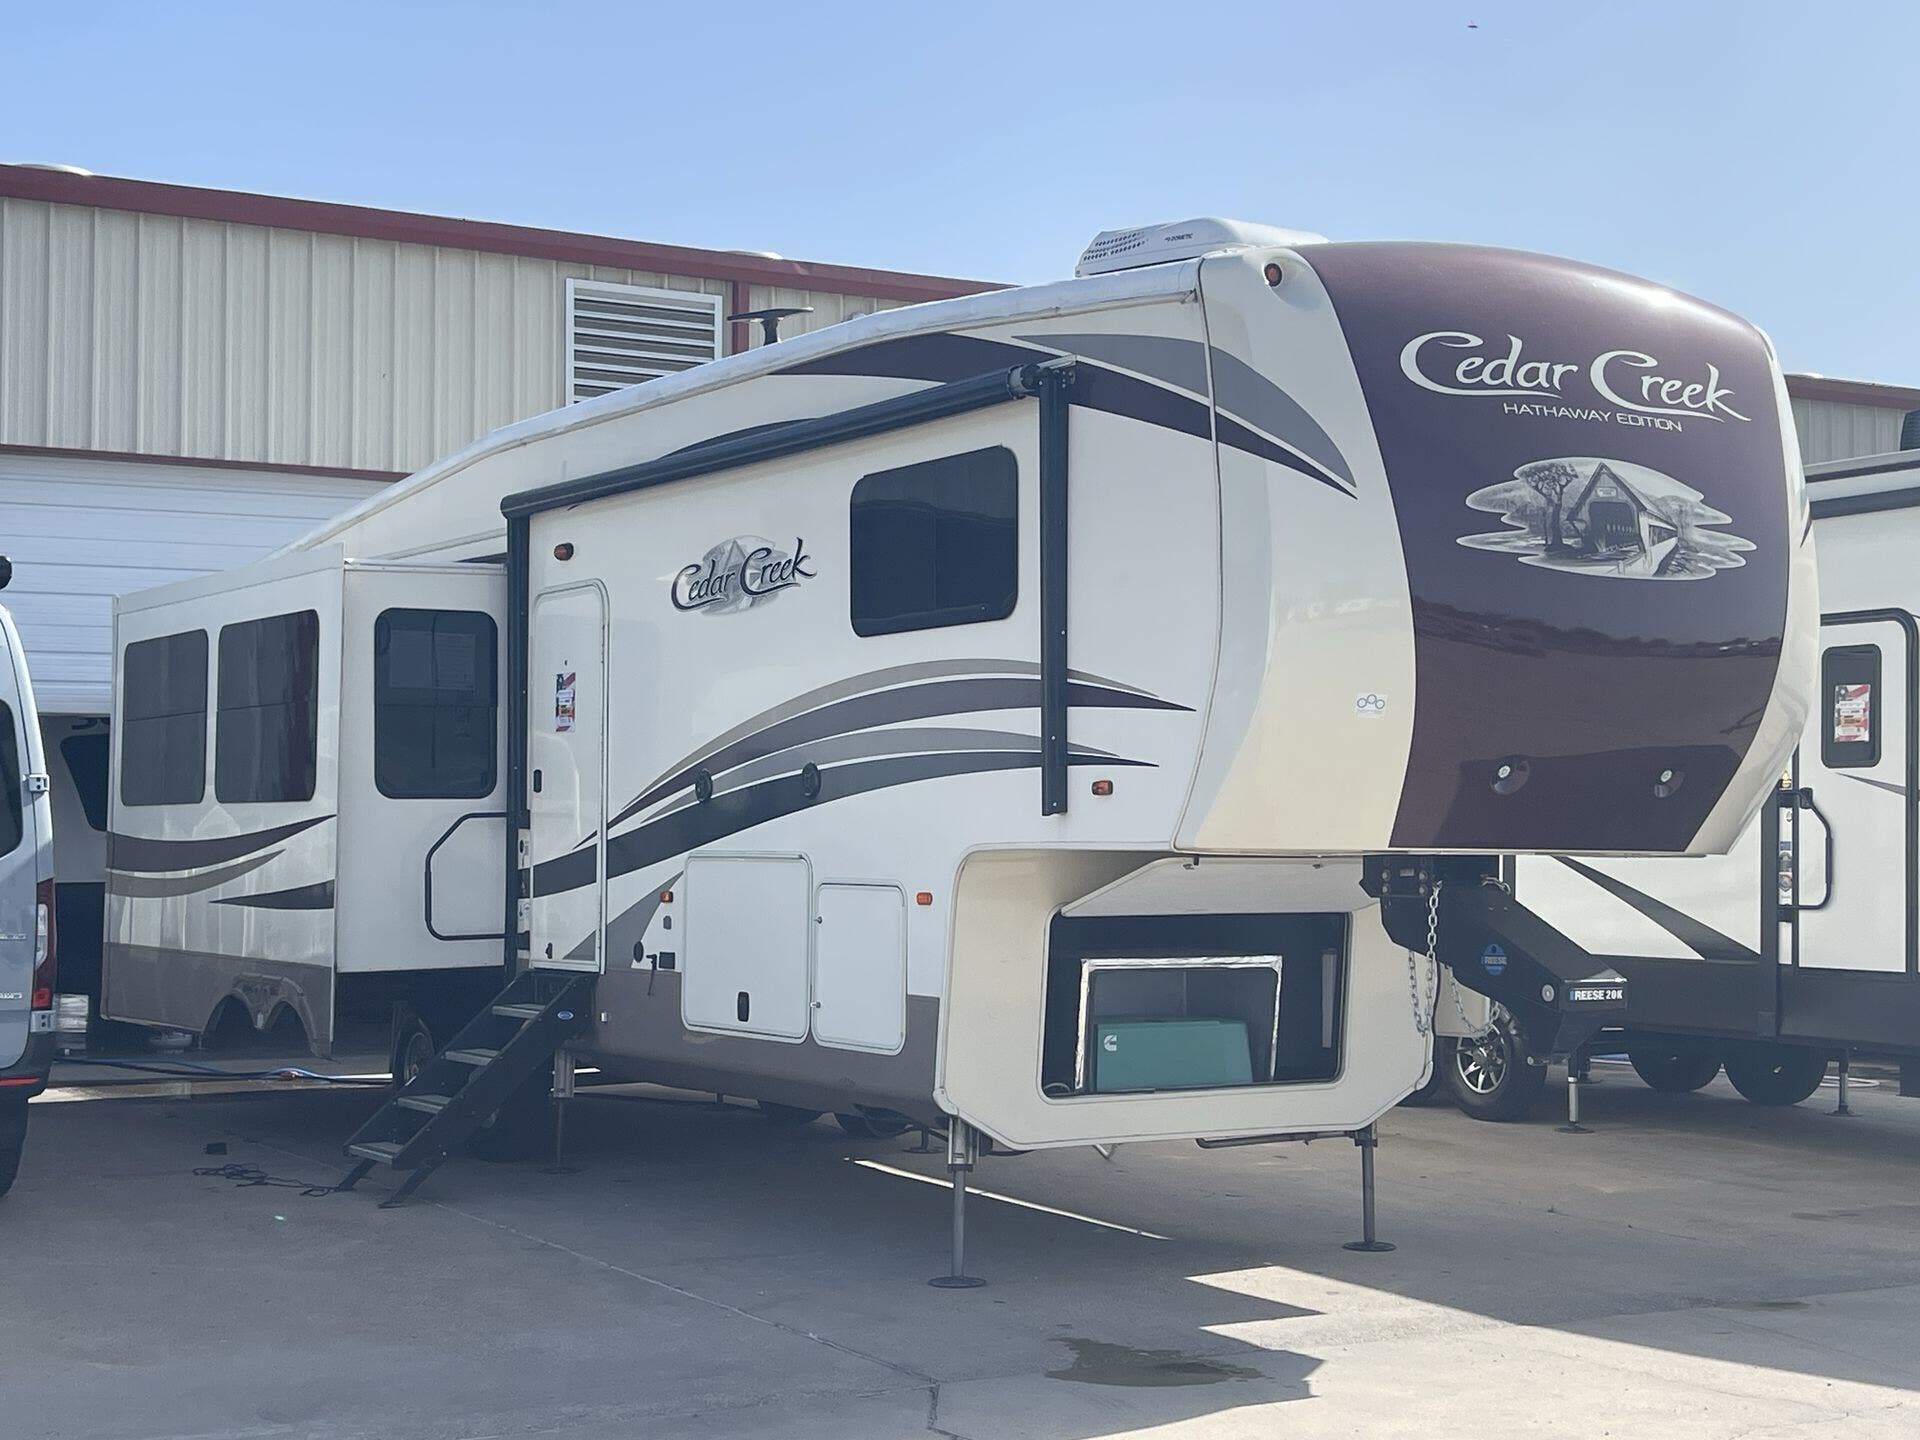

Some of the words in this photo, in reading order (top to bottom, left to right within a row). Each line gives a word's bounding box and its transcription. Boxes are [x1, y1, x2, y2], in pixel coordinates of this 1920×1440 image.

[1400, 331, 1579, 400] Cedar
[1590, 350, 1752, 423] Creek
[1503, 402, 1612, 422] HATHAWAY
[1616, 412, 1683, 432] EDITION
[670, 559, 736, 611] Cedar
[740, 537, 818, 596] Creek
[1574, 990, 1605, 1001] REESE
[1606, 989, 1623, 1000] 20K
